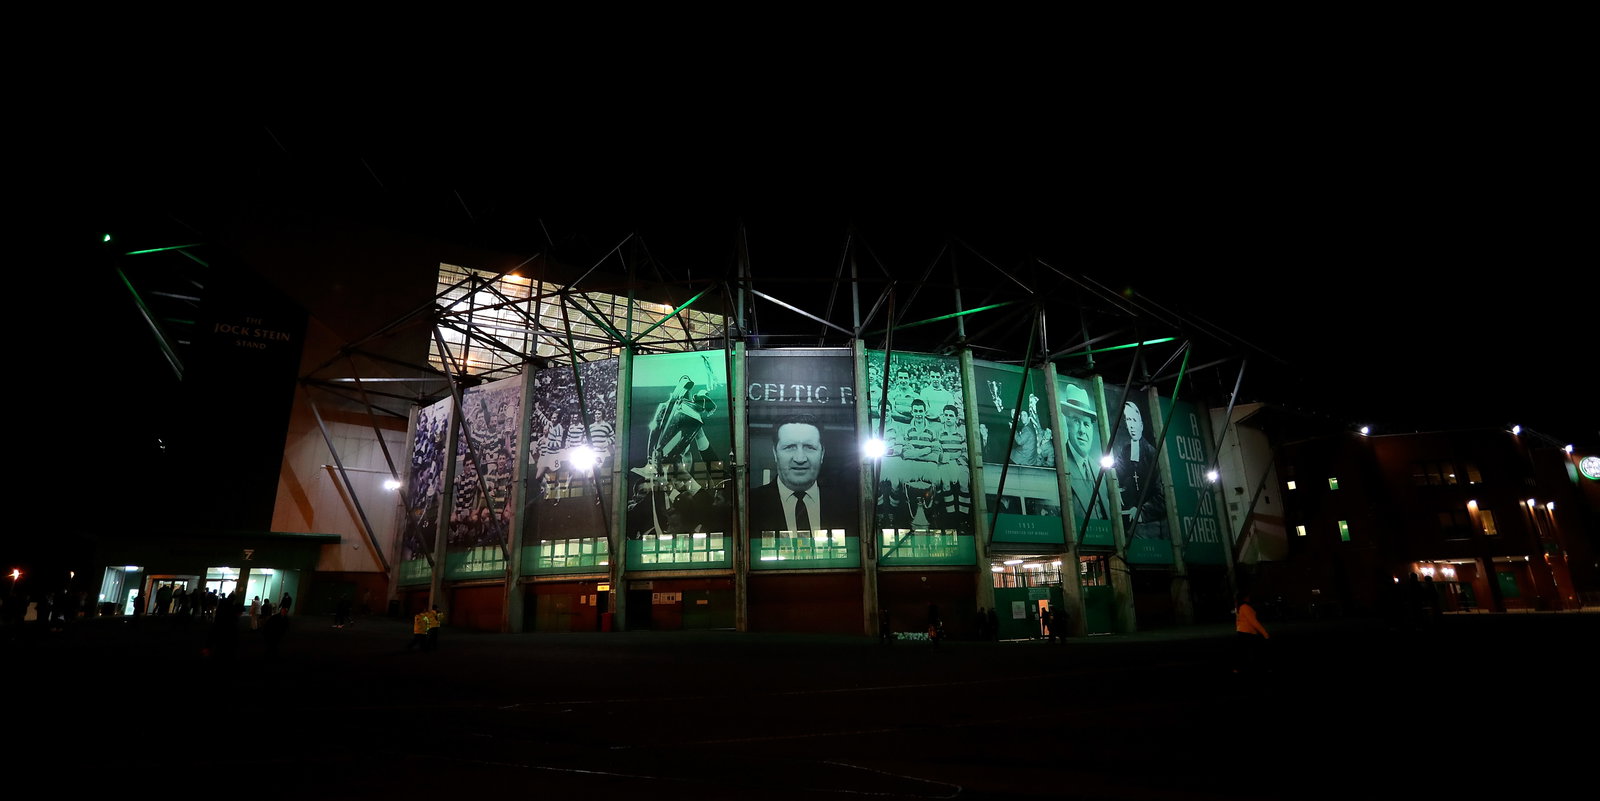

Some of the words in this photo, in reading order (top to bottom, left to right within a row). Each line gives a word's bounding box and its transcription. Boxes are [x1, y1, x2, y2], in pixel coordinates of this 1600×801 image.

[246, 316, 263, 325] THE
[214, 322, 250, 336] JOCK
[253, 328, 291, 342] STEIN
[235, 339, 267, 350] STAND
[748, 382, 830, 404] CELTIC
[1189, 412, 1200, 437] A
[1176, 435, 1205, 462] CLUB
[1183, 516, 1220, 543] OTHER
